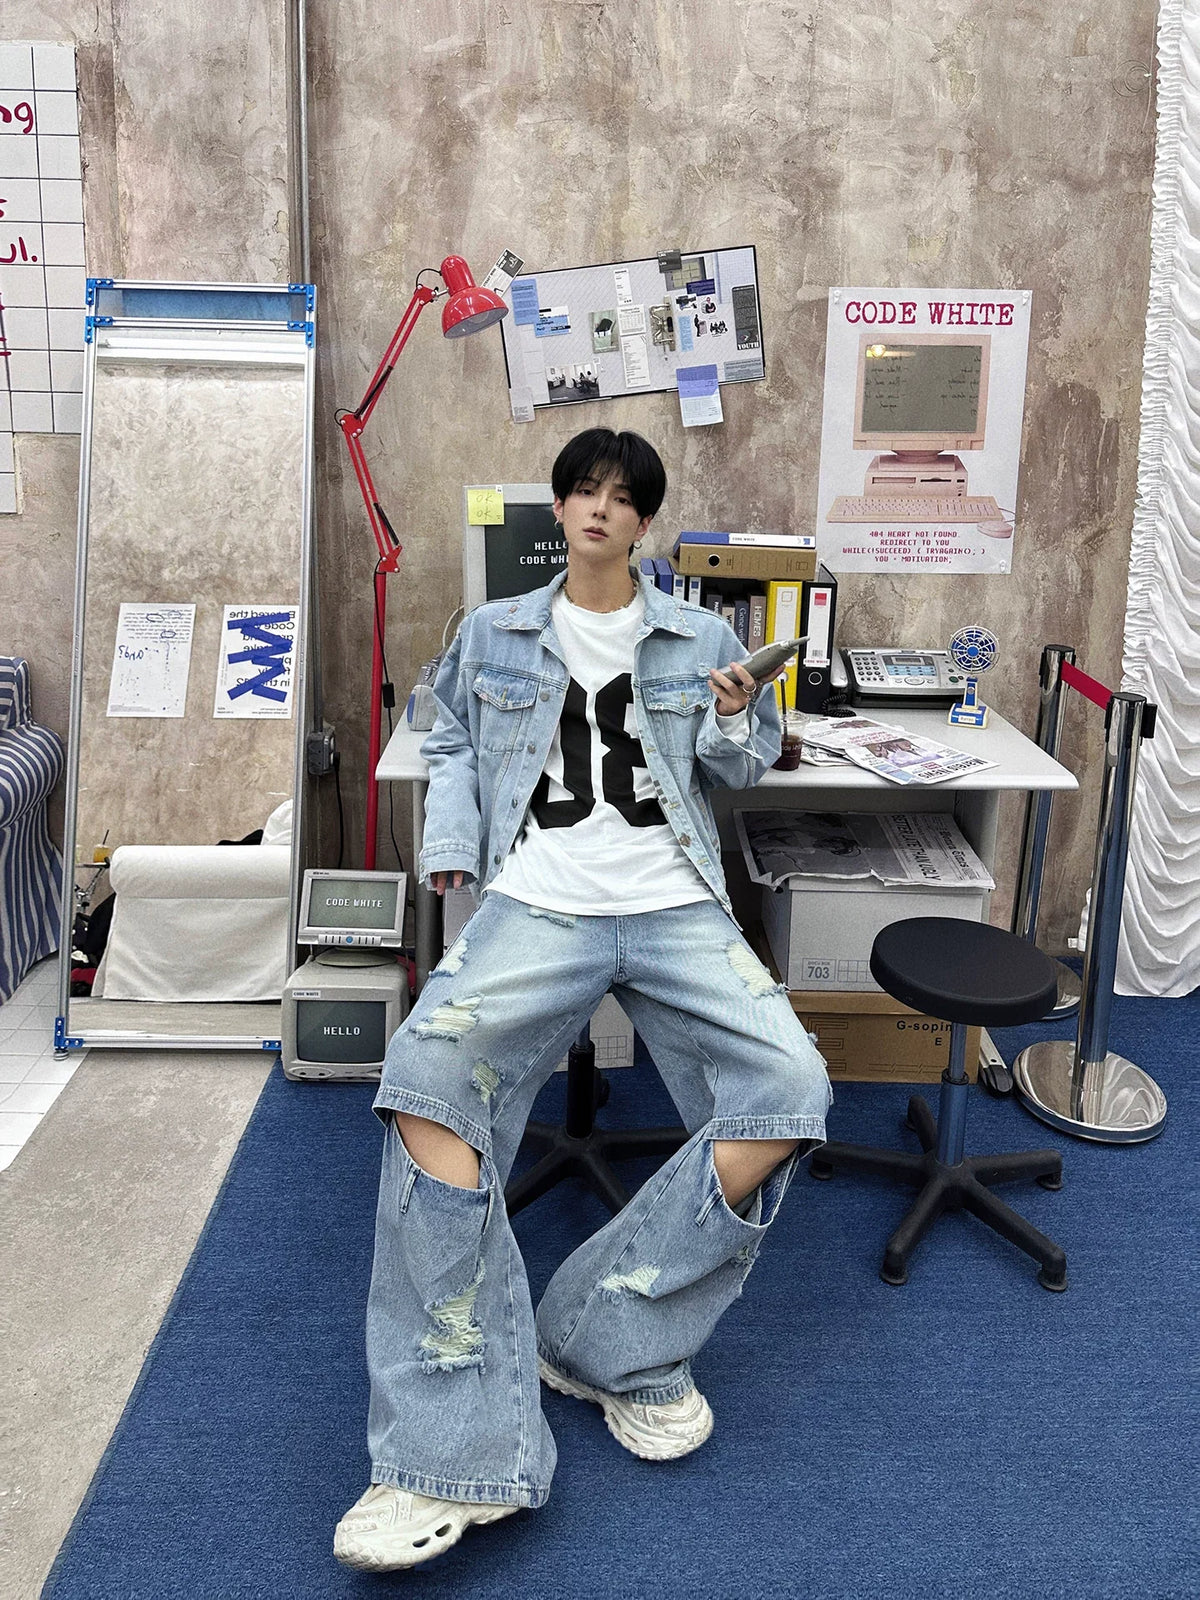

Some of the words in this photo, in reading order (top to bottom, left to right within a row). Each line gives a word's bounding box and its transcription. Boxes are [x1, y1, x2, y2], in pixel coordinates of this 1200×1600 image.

[845, 301, 918, 324] CODE
[928, 302, 1015, 325] WHITE
[738, 342, 759, 350] YOUTH
[476, 492, 494, 504] OK
[519, 555, 547, 565] CODE
[738, 607, 747, 628] Gone
[753, 605, 762, 637] HOMES
[326, 898, 350, 907] CODE
[353, 899, 383, 908] WHITE
[807, 966, 830, 979] 703
[323, 1026, 361, 1036] HELLO
[934, 1037, 943, 1046] E
